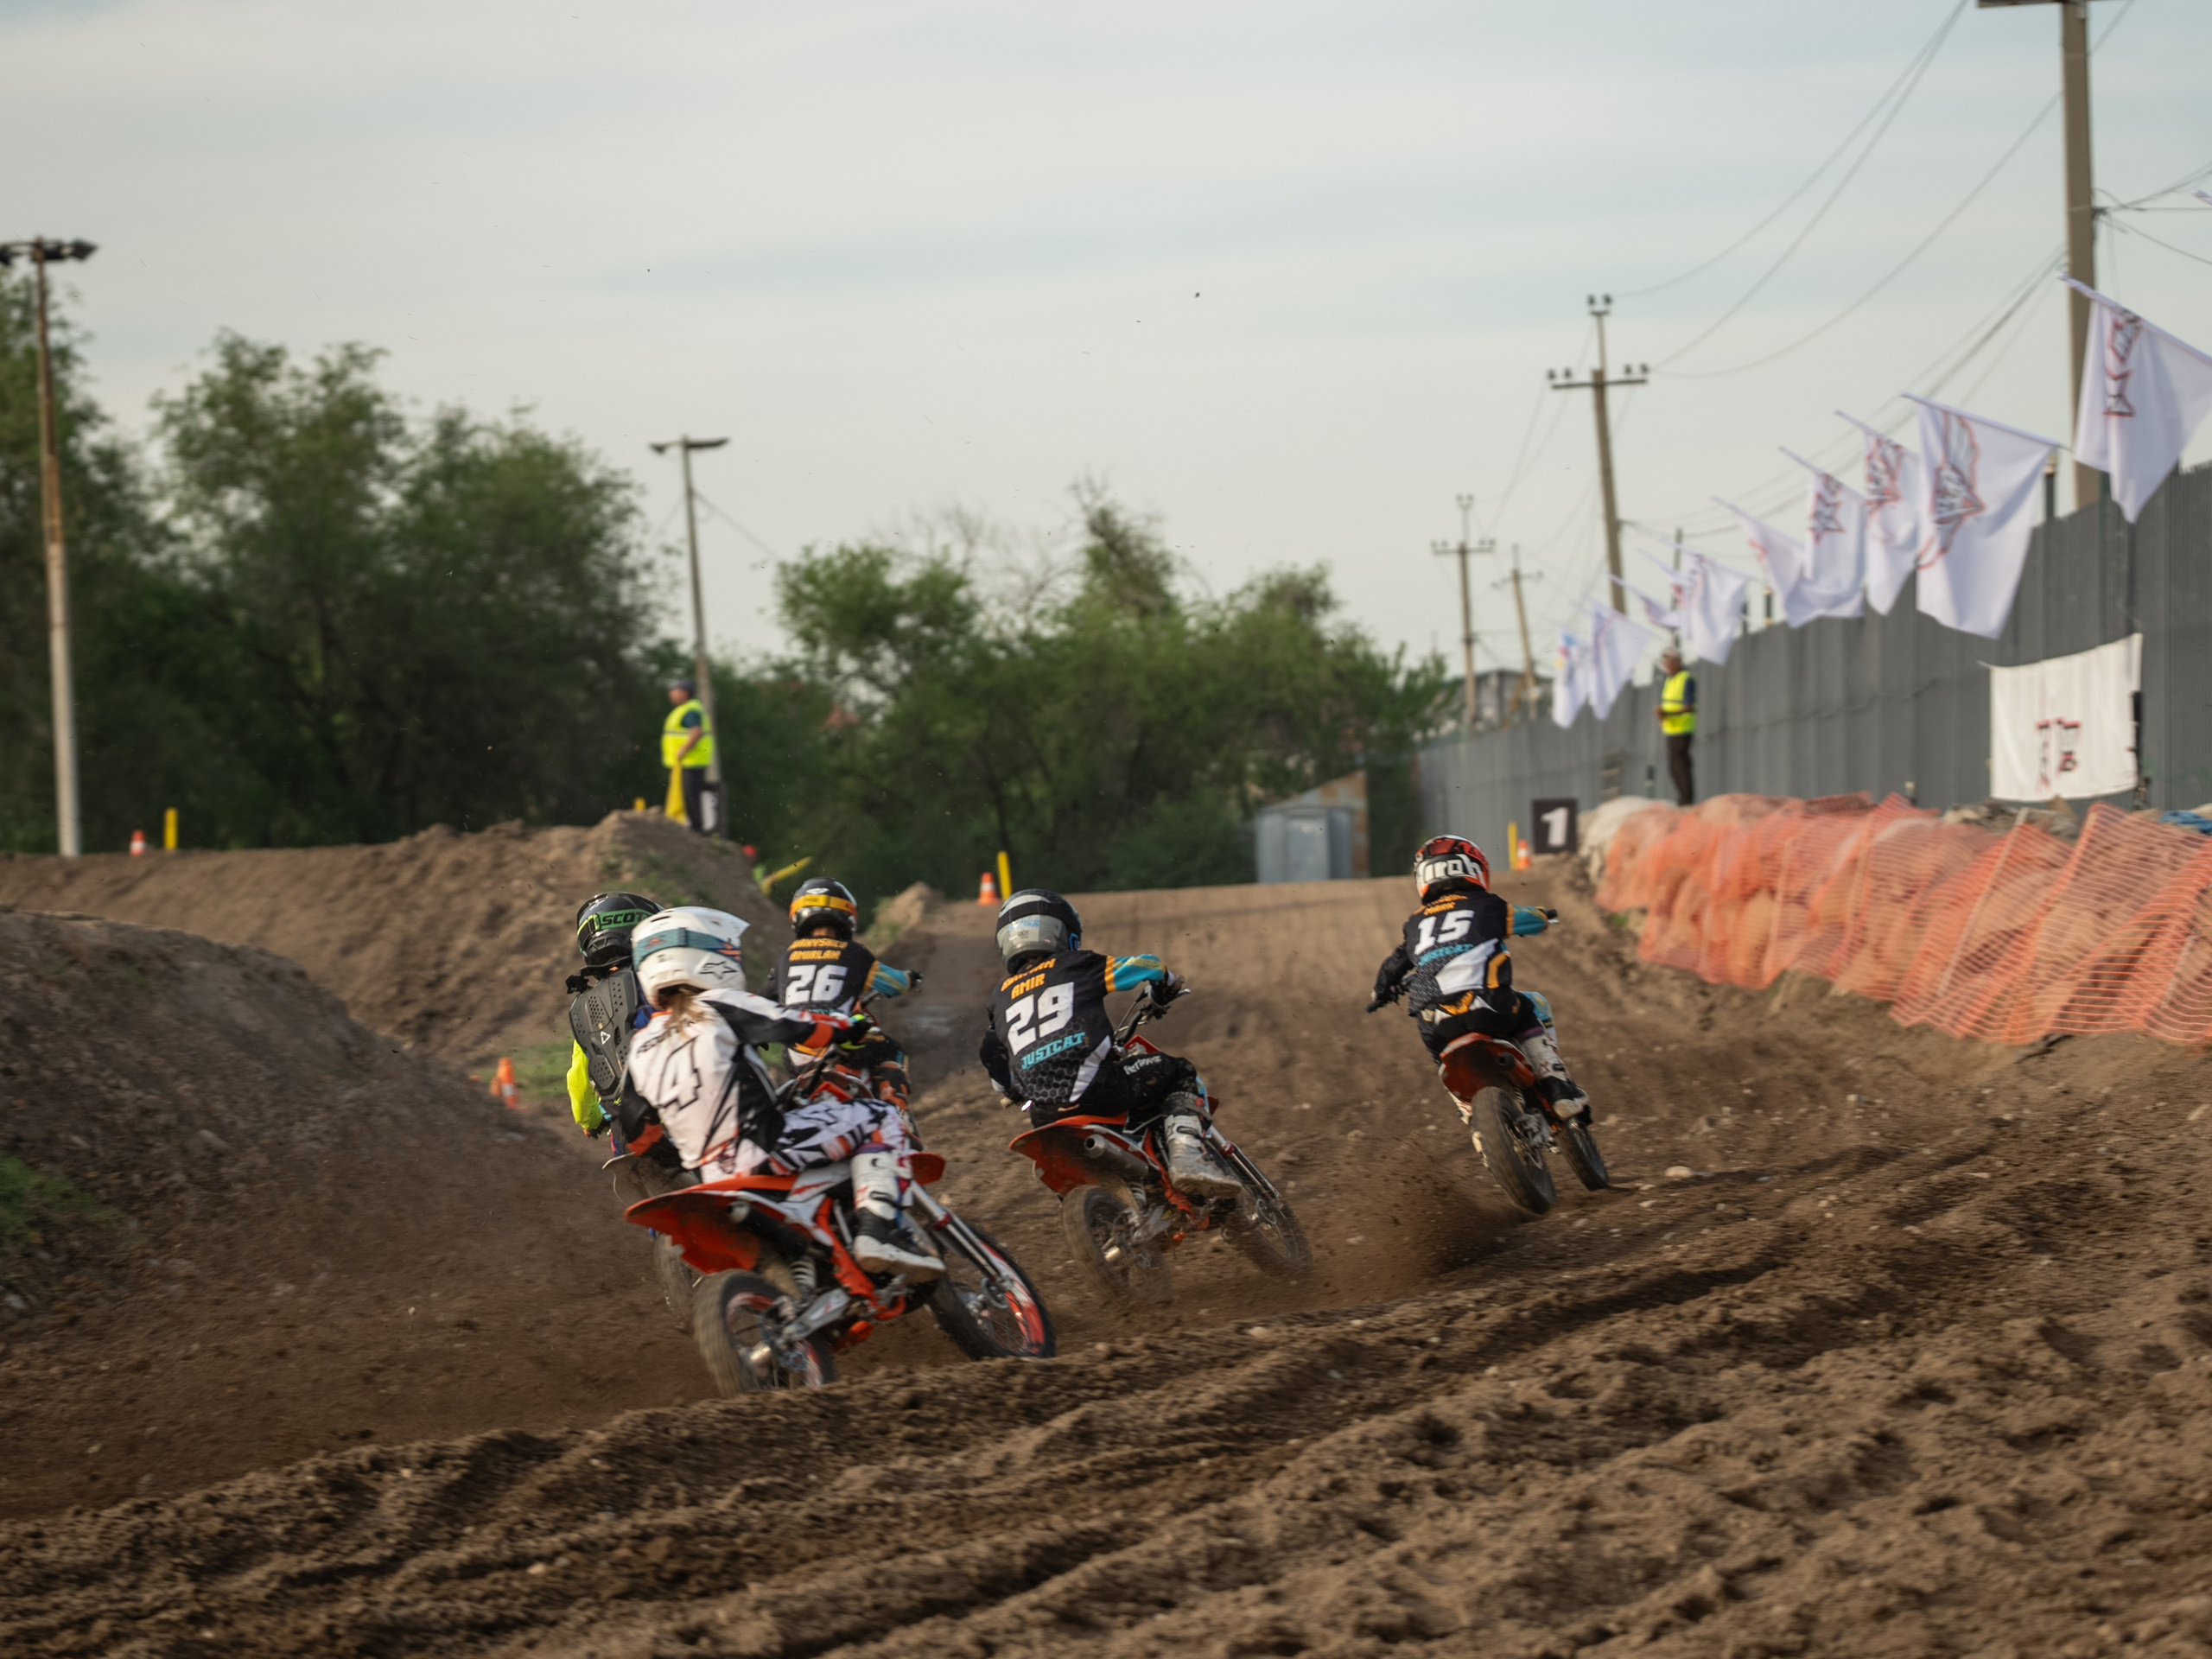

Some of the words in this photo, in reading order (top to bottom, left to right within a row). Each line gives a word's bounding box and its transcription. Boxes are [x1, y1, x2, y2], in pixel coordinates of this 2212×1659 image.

[1541, 807, 1568, 847] 1
[601, 912, 650, 925] SCOT
[1414, 909, 1474, 955] 15
[785, 964, 849, 1005] 26
[1011, 973, 1046, 1000] AMIR
[1005, 982, 1074, 1056] 29
[1020, 1032, 1085, 1070] JUSTCAT
[657, 1035, 702, 1111] 4
